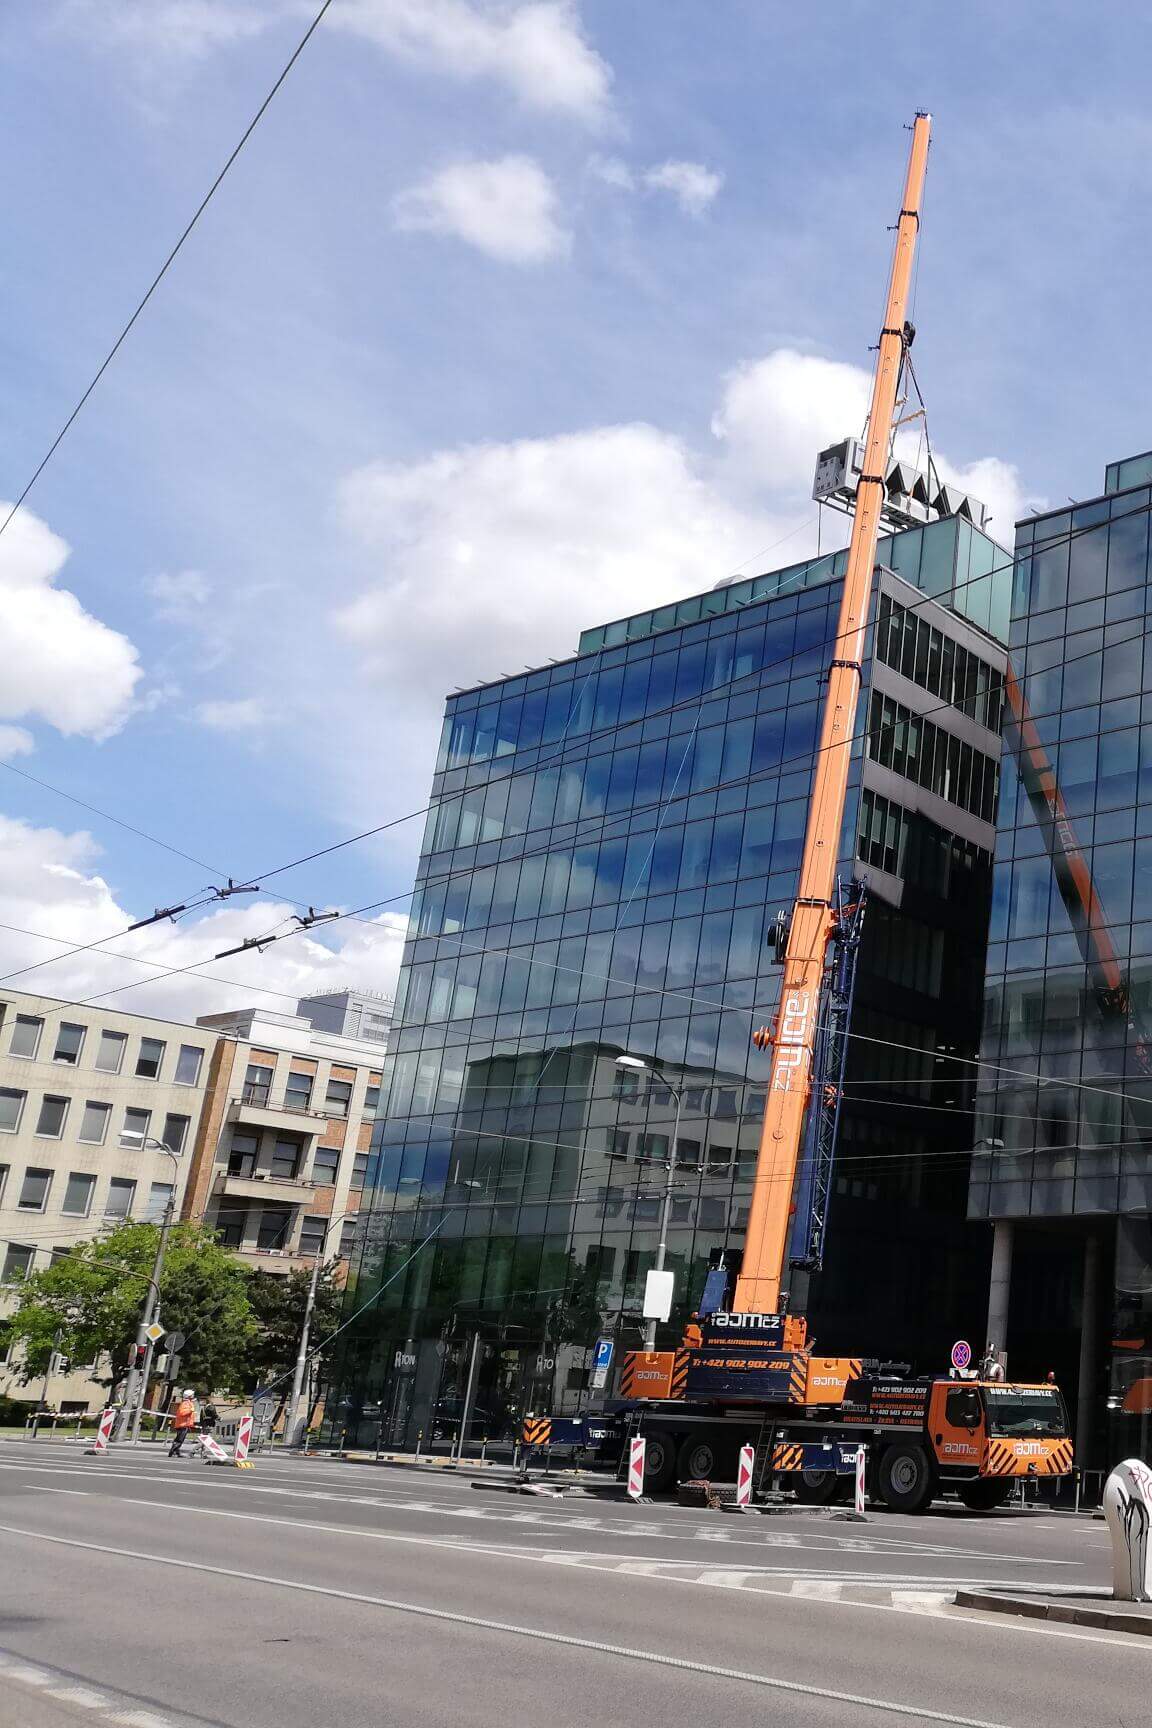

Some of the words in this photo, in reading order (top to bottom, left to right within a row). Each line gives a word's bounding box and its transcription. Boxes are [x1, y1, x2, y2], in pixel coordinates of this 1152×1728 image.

[598, 1343, 608, 1359] P
[702, 1359, 725, 1368] +421
[726, 1359, 747, 1368] 902
[748, 1360, 769, 1369] 902
